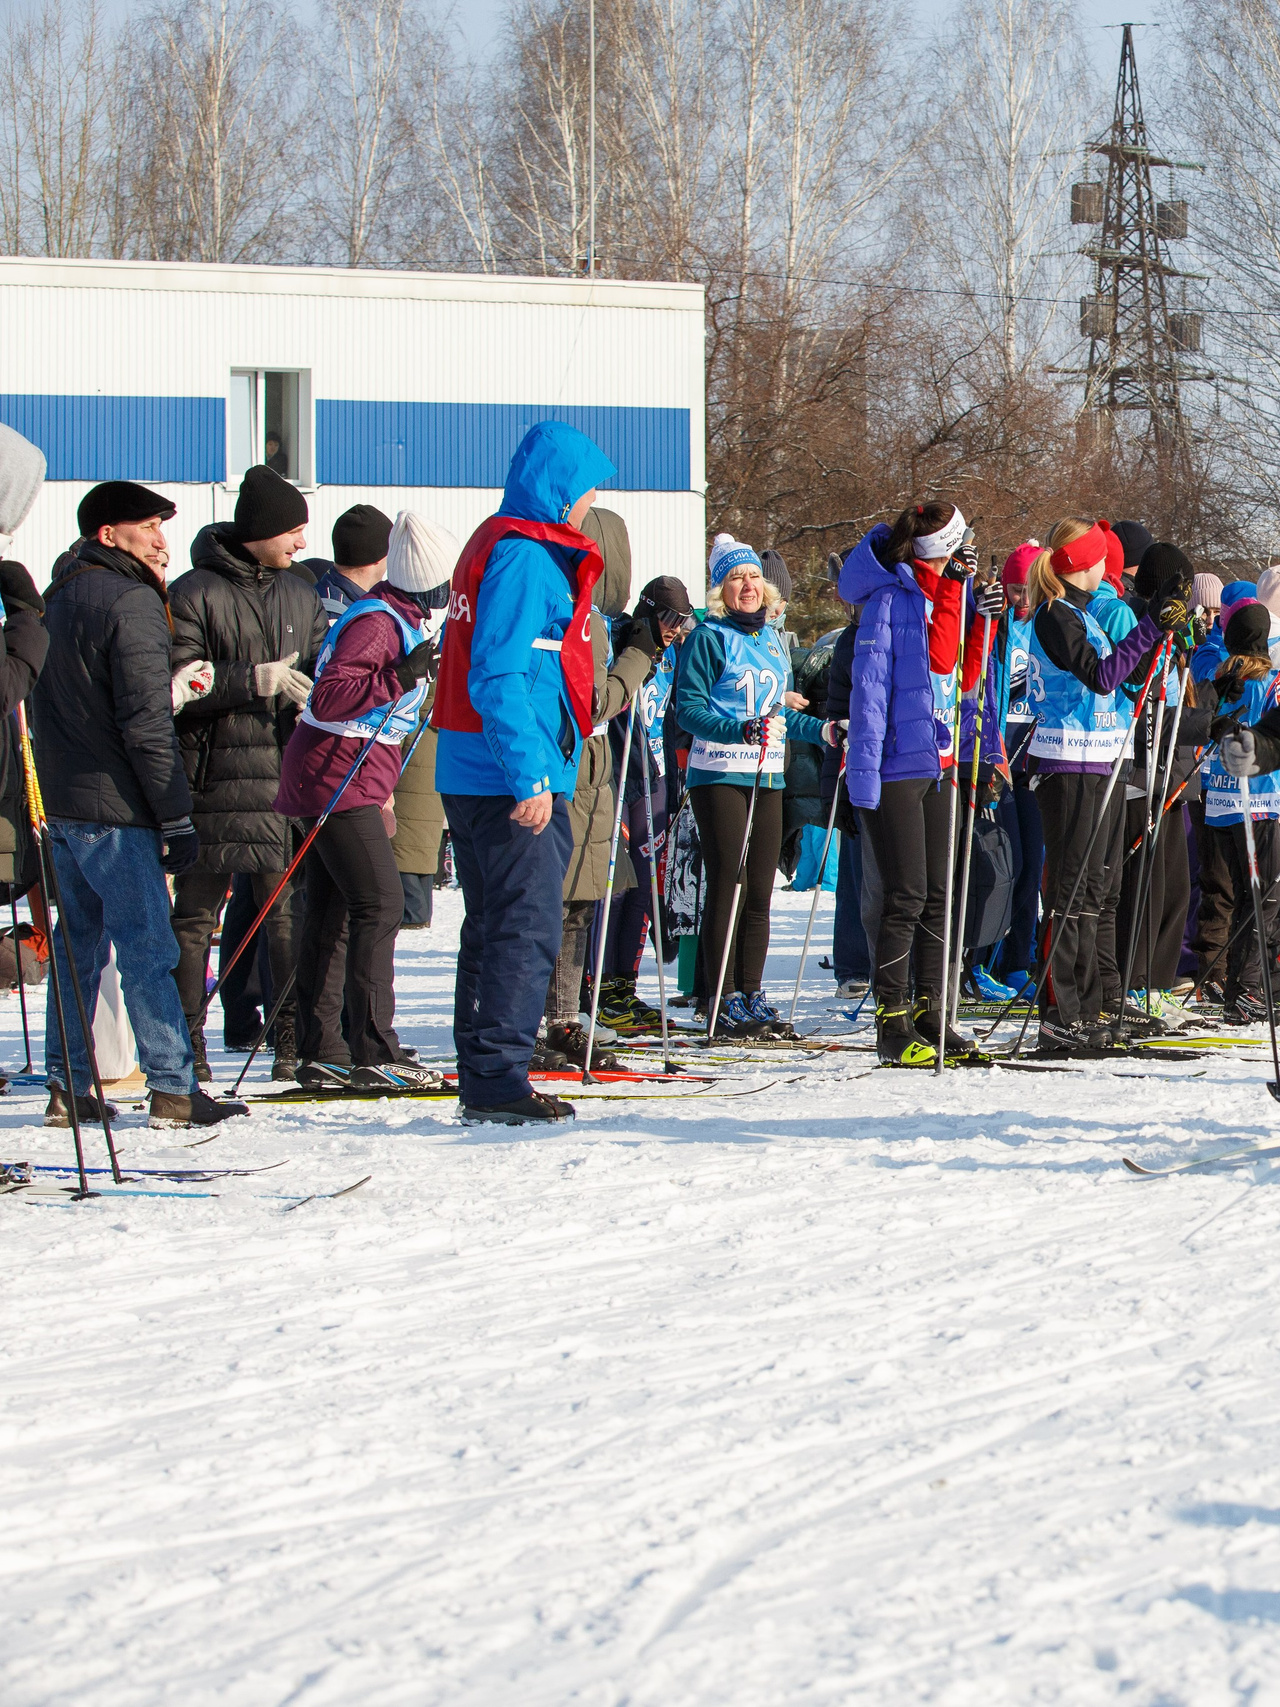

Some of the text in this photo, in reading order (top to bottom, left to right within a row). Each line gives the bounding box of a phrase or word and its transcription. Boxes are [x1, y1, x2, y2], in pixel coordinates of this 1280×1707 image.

[735, 668, 788, 717] 12
[1068, 737, 1094, 748] КУБОК
[708, 750, 737, 760] КУБОК
[740, 751, 760, 760] ГЛАВ
[1238, 799, 1272, 809] ТМЕНИ
[978, 984, 1007, 1000] PINE
[719, 1040, 808, 1050] SABLE
